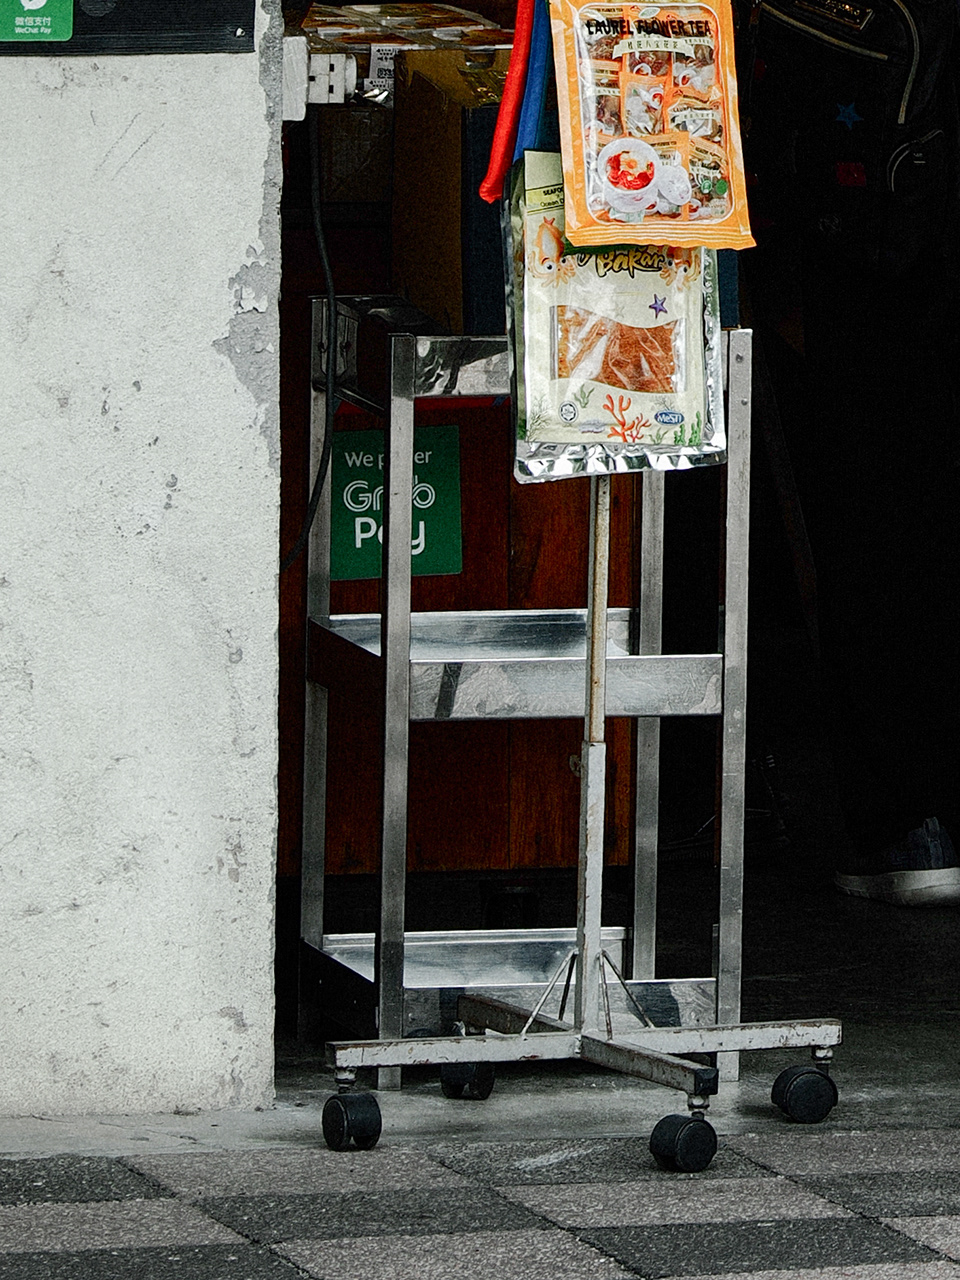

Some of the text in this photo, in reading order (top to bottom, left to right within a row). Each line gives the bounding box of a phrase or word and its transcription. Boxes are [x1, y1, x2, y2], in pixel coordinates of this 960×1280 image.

[14, 26, 39, 34] WeChat
[585, 19, 713, 38] LAUREL FLOWER TEA
[344, 451, 374, 468] We
[342, 474, 436, 512] Grb
[354, 516, 426, 556] Py
